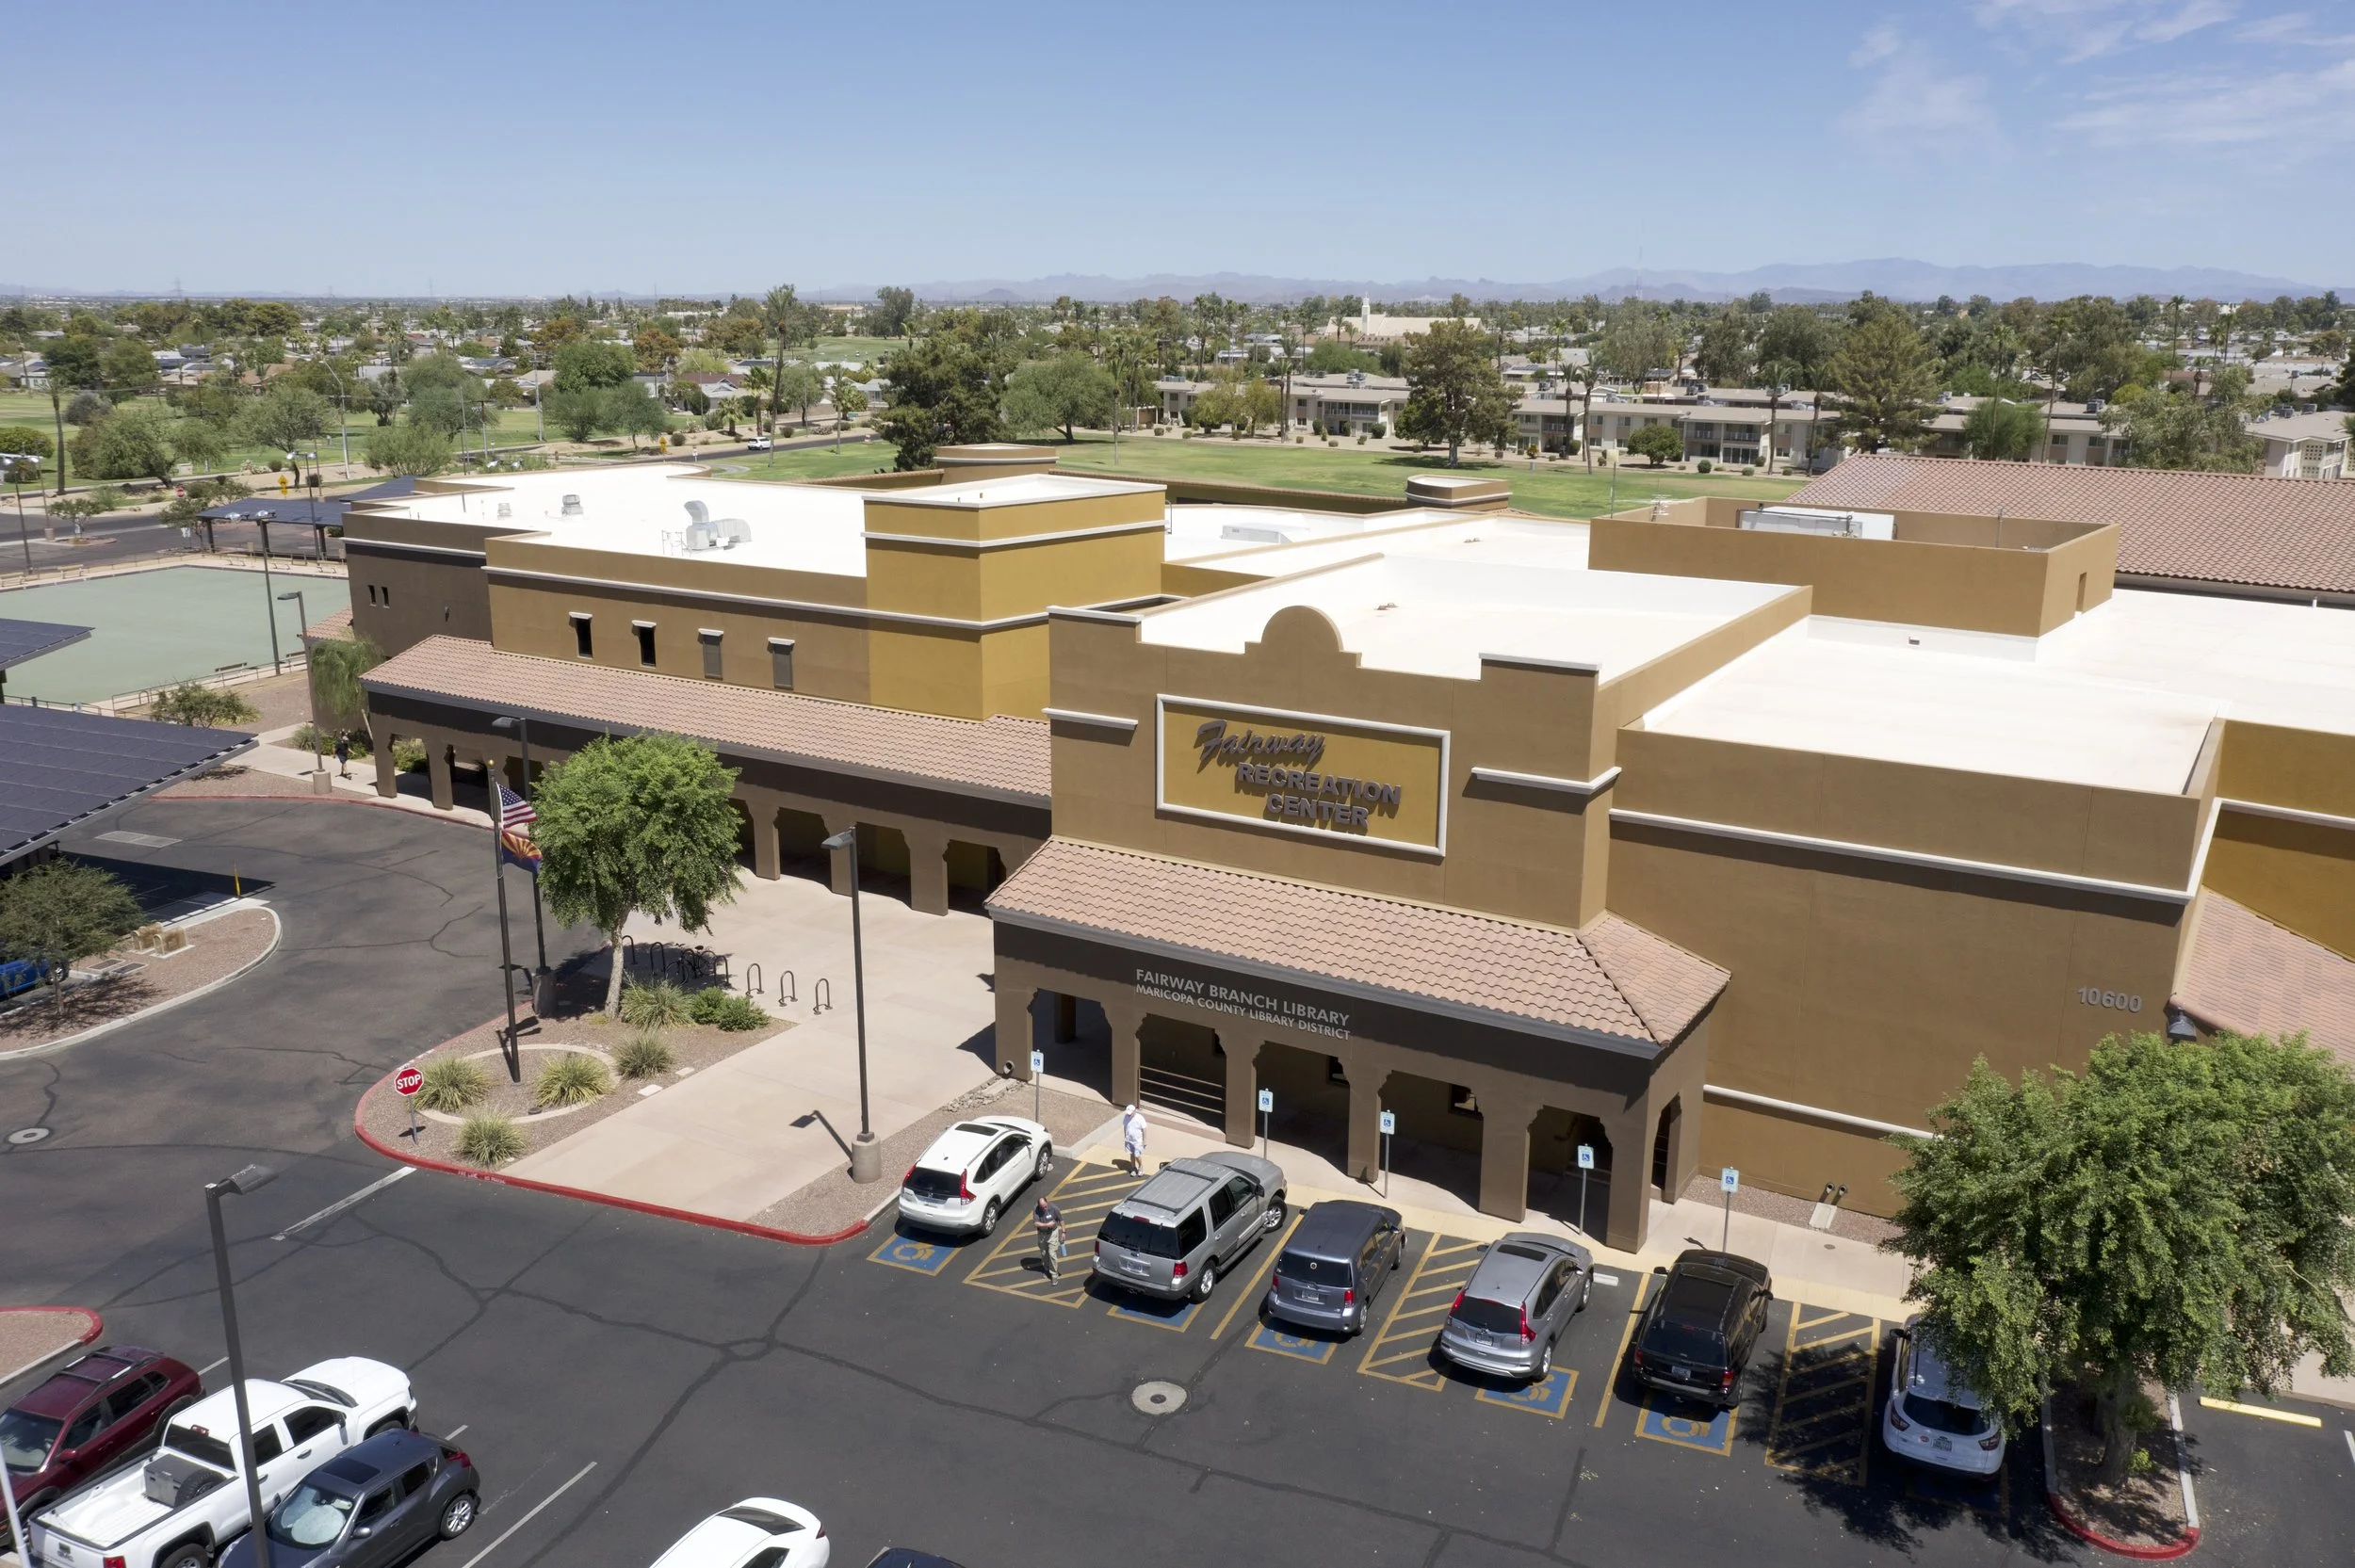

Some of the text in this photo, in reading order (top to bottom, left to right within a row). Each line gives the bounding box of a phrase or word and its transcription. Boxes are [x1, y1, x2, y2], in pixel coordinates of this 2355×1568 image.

[1196, 719, 1326, 763] Fairway
[1239, 761, 1402, 804] RECREATION
[1266, 793, 1370, 826] CENTER
[1136, 968, 1350, 1026] FAIRWAY BRANCH LIBRARY
[1136, 983, 1351, 1041] MARICOPA COUNTY LIBRARY DISTRICT
[2077, 985, 2142, 1012] 10600
[397, 1074, 421, 1090] STOP
